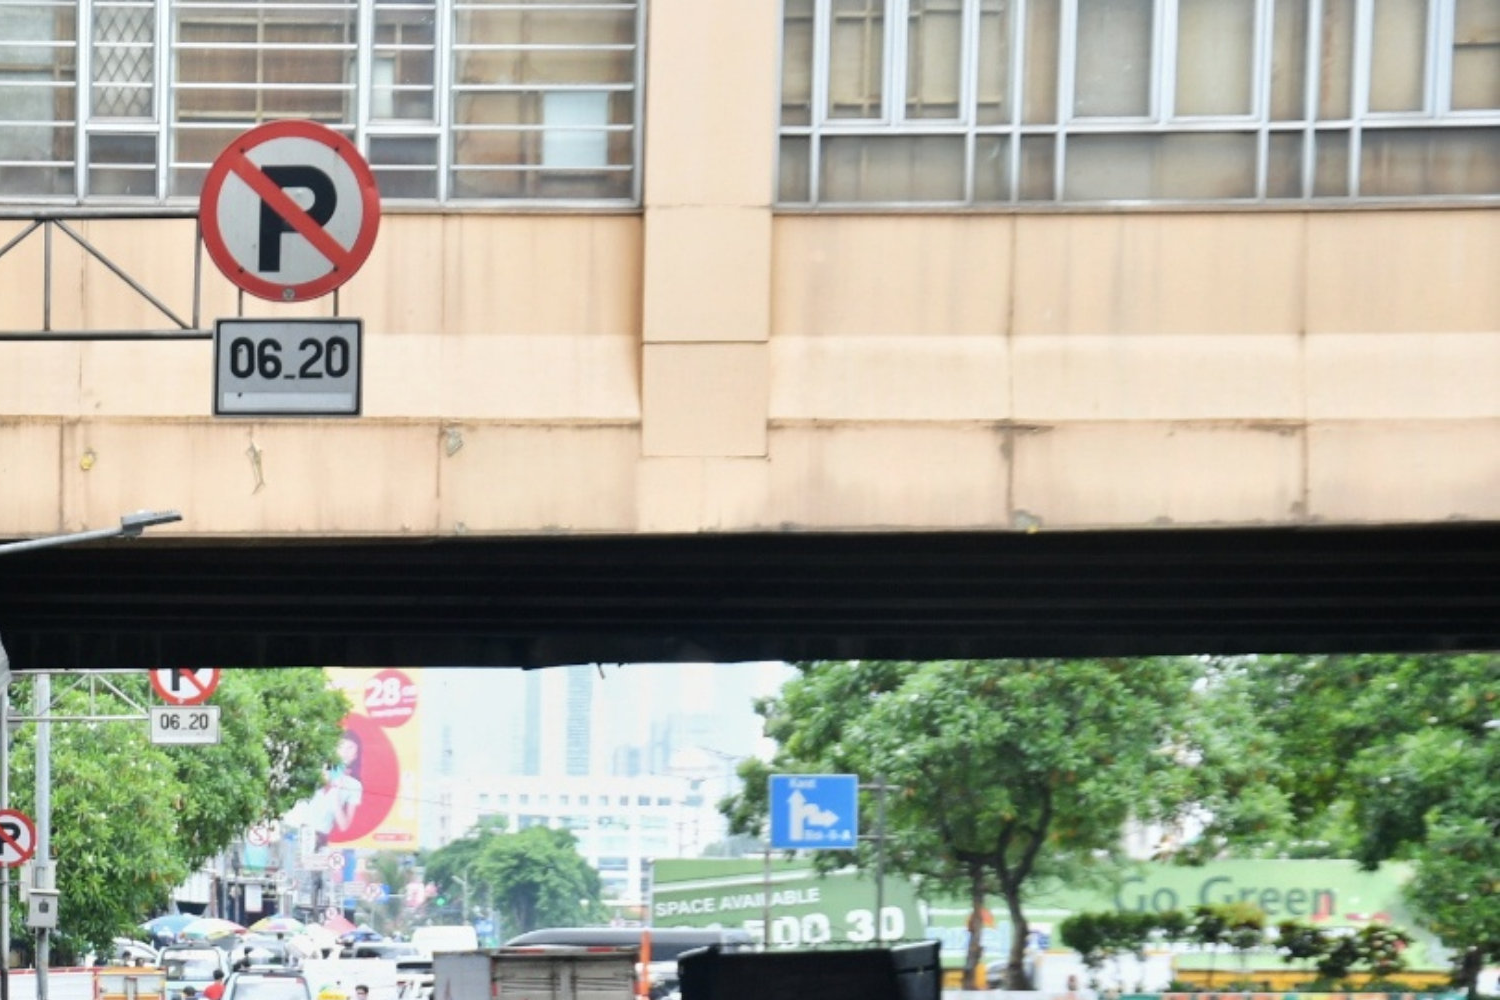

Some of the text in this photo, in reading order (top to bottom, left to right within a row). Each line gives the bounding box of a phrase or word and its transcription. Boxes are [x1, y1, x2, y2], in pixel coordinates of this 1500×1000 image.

[364, 677, 401, 707] 28
[654, 896, 715, 917] SPACE
[1114, 874, 1337, 917] Go Green
